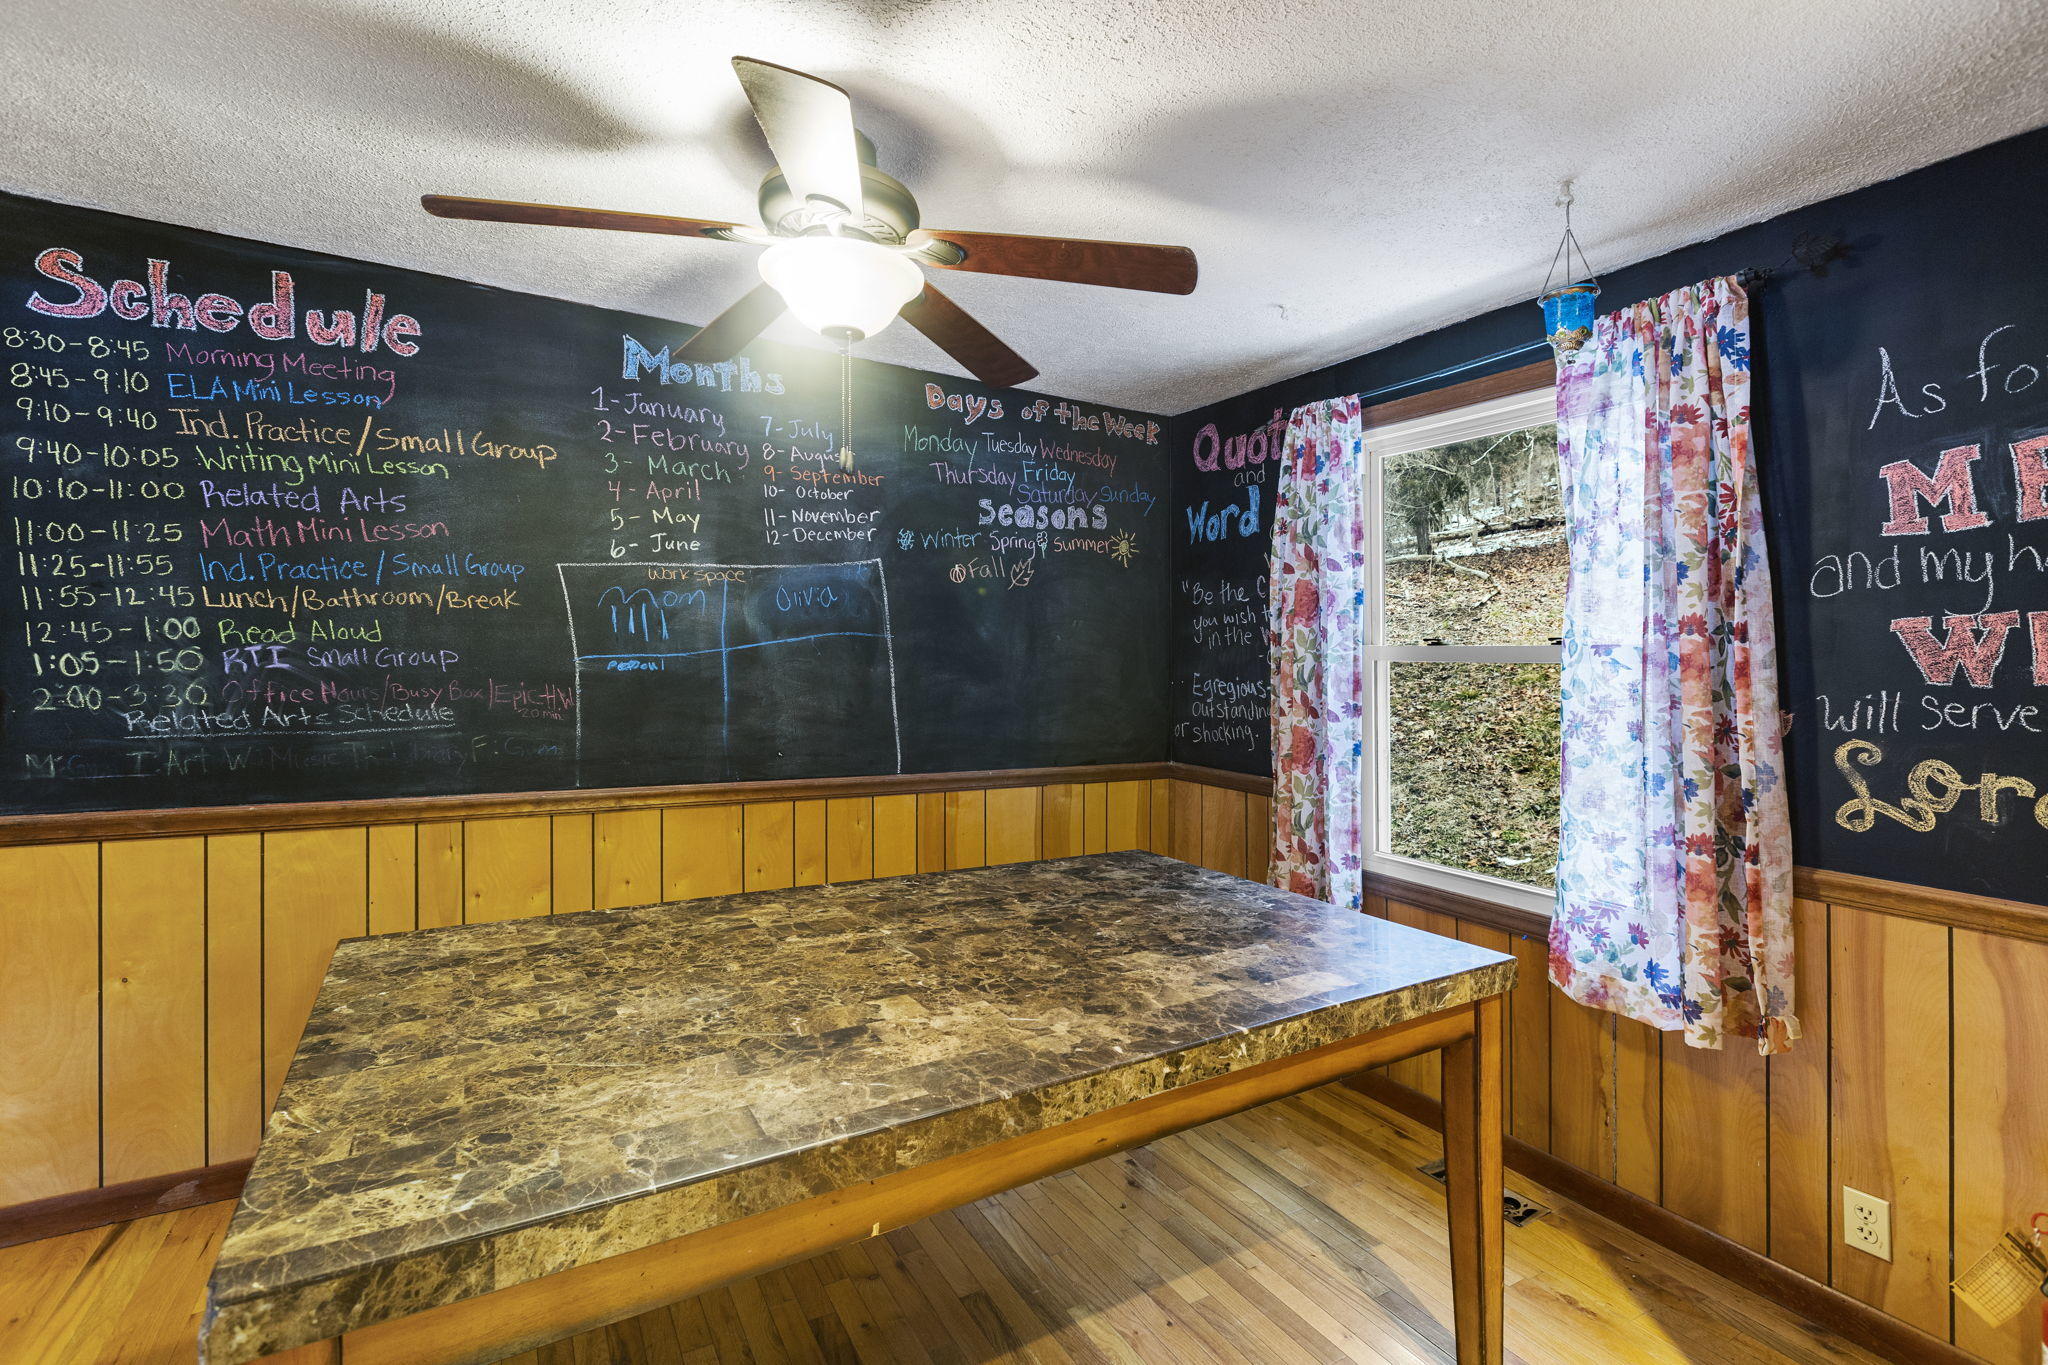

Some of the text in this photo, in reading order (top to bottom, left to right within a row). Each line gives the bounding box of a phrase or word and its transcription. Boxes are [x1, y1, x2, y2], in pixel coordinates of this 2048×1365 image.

[26, 247, 422, 357] Schedule
[166, 342, 396, 404] Morning Meeting
[622, 334, 785, 395] Months
[1868, 324, 2048, 429] As fo
[166, 373, 382, 410] ELA Mini Lesson
[624, 392, 725, 438] January
[924, 383, 1160, 445] Days of the Week
[168, 407, 239, 440] Ind.
[471, 430, 558, 469] Group
[632, 423, 750, 471] February
[788, 419, 834, 452] July
[904, 424, 1117, 477] Monday Tuesday Wednesday
[197, 445, 449, 486] Writing Mini Lesson
[647, 454, 732, 483] March
[790, 445, 853, 473] Augus
[790, 465, 885, 488] September
[929, 459, 1075, 496] Thursday Friday
[1234, 463, 1266, 487] and
[199, 479, 406, 514] Related Arts
[646, 479, 702, 504] April
[796, 486, 854, 501] October
[1017, 482, 1156, 517] Saturday Sunday
[652, 506, 701, 533] May
[792, 509, 880, 525] November
[978, 499, 1107, 529] Seasons
[1186, 484, 1260, 545] Word
[200, 516, 450, 548] Math Mini Lesson
[651, 532, 701, 553] June
[793, 527, 877, 543] December
[920, 527, 1114, 560] Winter Spring Summer
[199, 552, 255, 582] Ind.
[257, 552, 368, 582] Practice
[392, 553, 459, 578] Small
[466, 553, 525, 583] Group
[696, 568, 745, 586] space
[967, 557, 1006, 578] Fall
[1810, 545, 1900, 597] and
[1920, 545, 1994, 616] my
[1220, 580, 1249, 603] the
[218, 619, 383, 644] Read Aloud
[1193, 616, 1218, 644] you
[1223, 604, 1256, 624] wish
[1208, 629, 1221, 649] in
[1225, 627, 1252, 646] the
[223, 644, 459, 675] RTI Small Group
[124, 702, 454, 732] Related Arts Schedule
[1174, 722, 1190, 738] or
